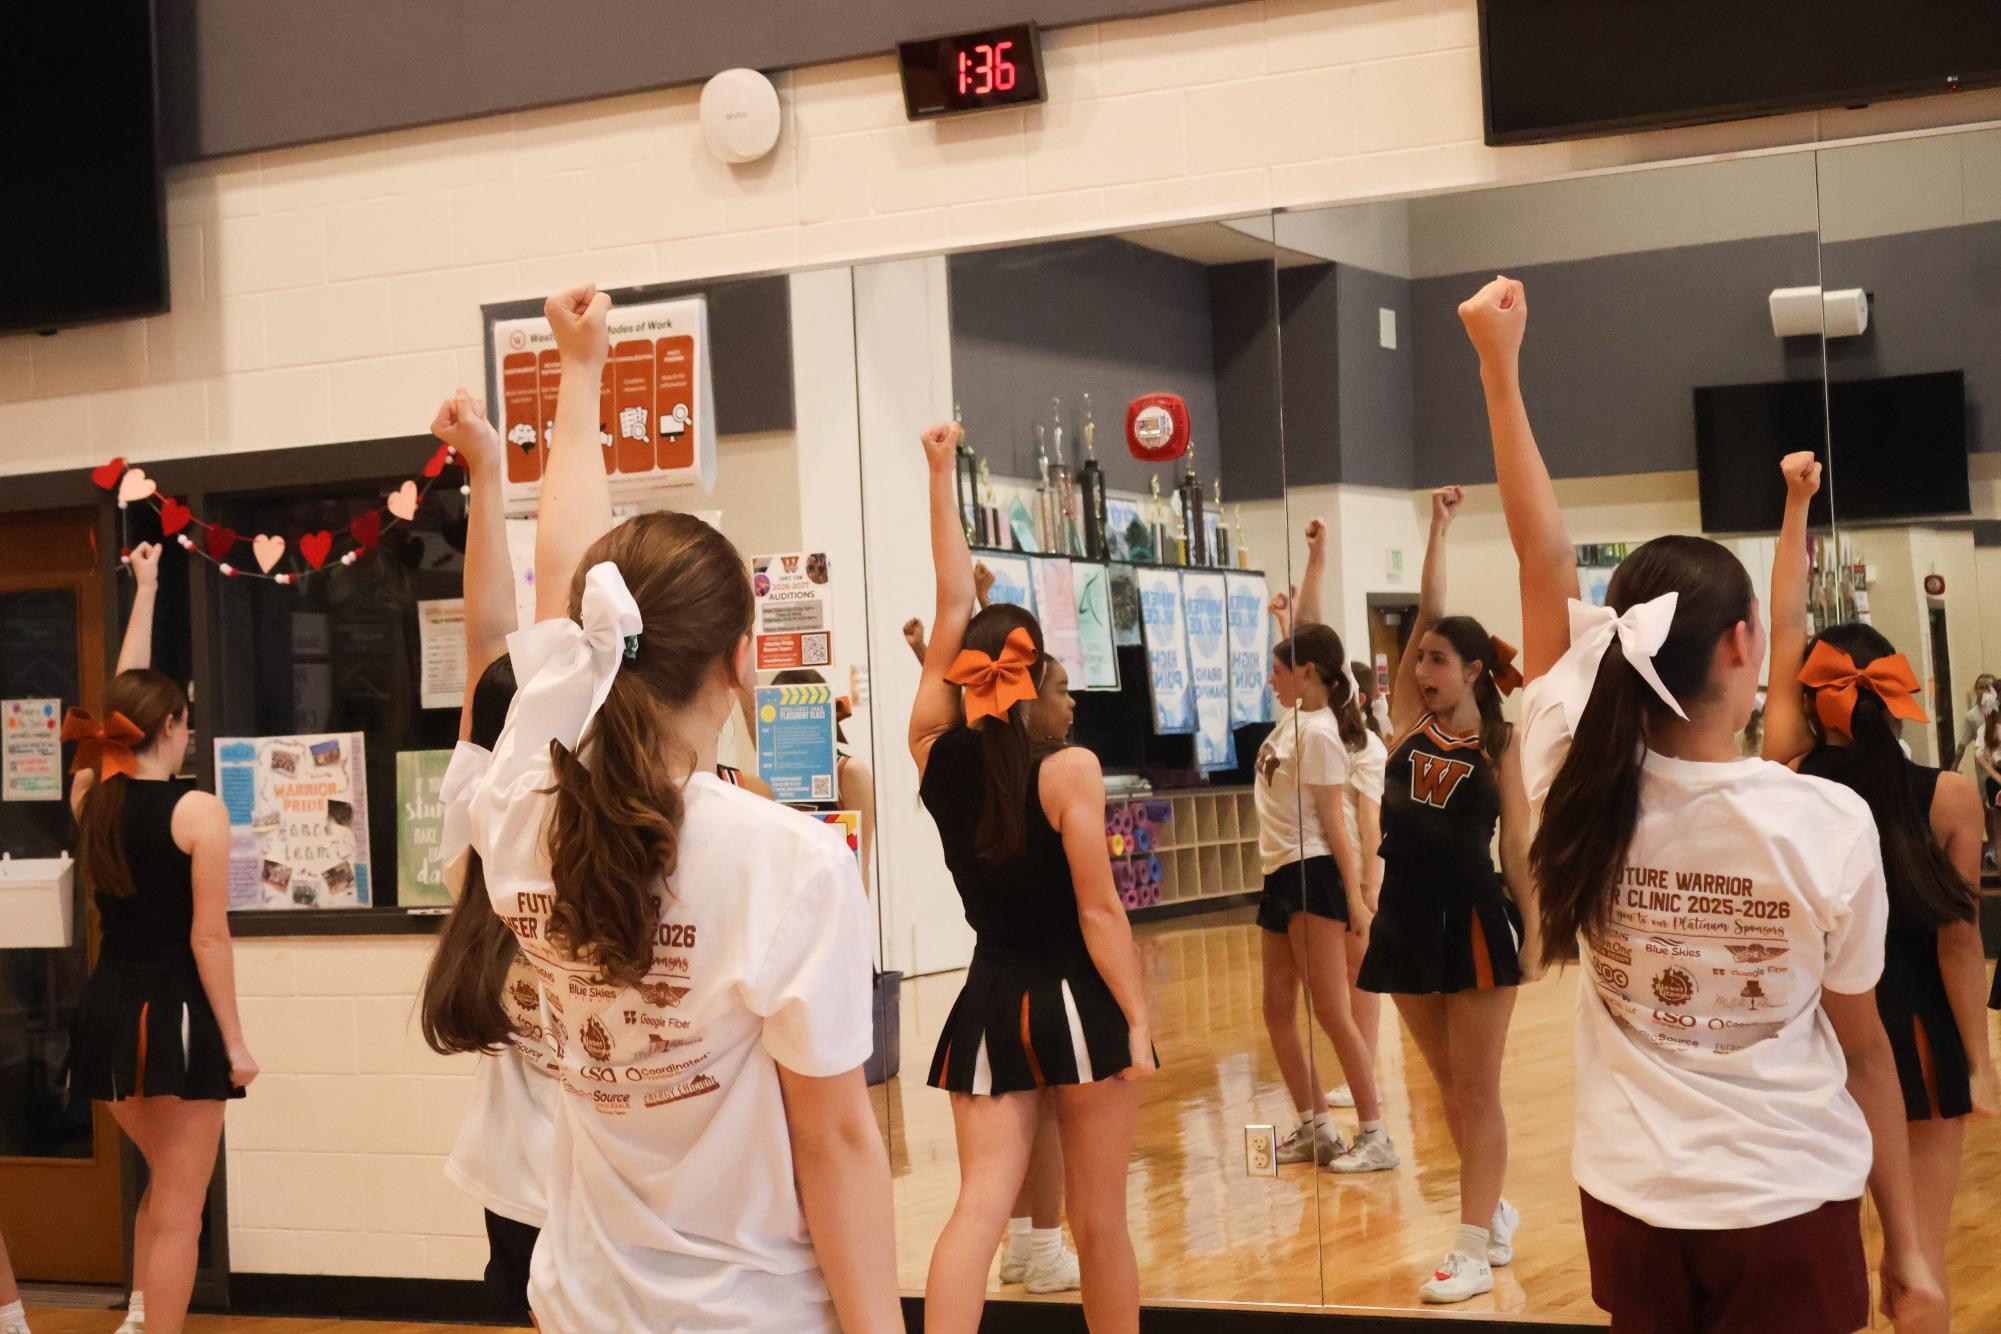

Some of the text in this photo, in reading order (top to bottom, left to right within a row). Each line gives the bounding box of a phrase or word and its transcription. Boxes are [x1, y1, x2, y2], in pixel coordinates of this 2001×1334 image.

[959, 41, 1016, 95] 1:36
[530, 334, 554, 343] West
[648, 319, 672, 330] Work
[768, 591, 816, 601] AUDITIONS
[283, 799, 326, 812] PRIDE
[1616, 867, 1753, 897] UTURE WARRIOR
[1627, 889, 1682, 913] CLINIC
[1687, 895, 1791, 920] 2025-2026
[1673, 915, 1730, 934] Platinum
[1734, 918, 1786, 937] Sponsors
[1645, 943, 1701, 958] Blue Skies
[568, 983, 617, 999] Blue Skies
[640, 1013, 691, 1029] Google Fiber
